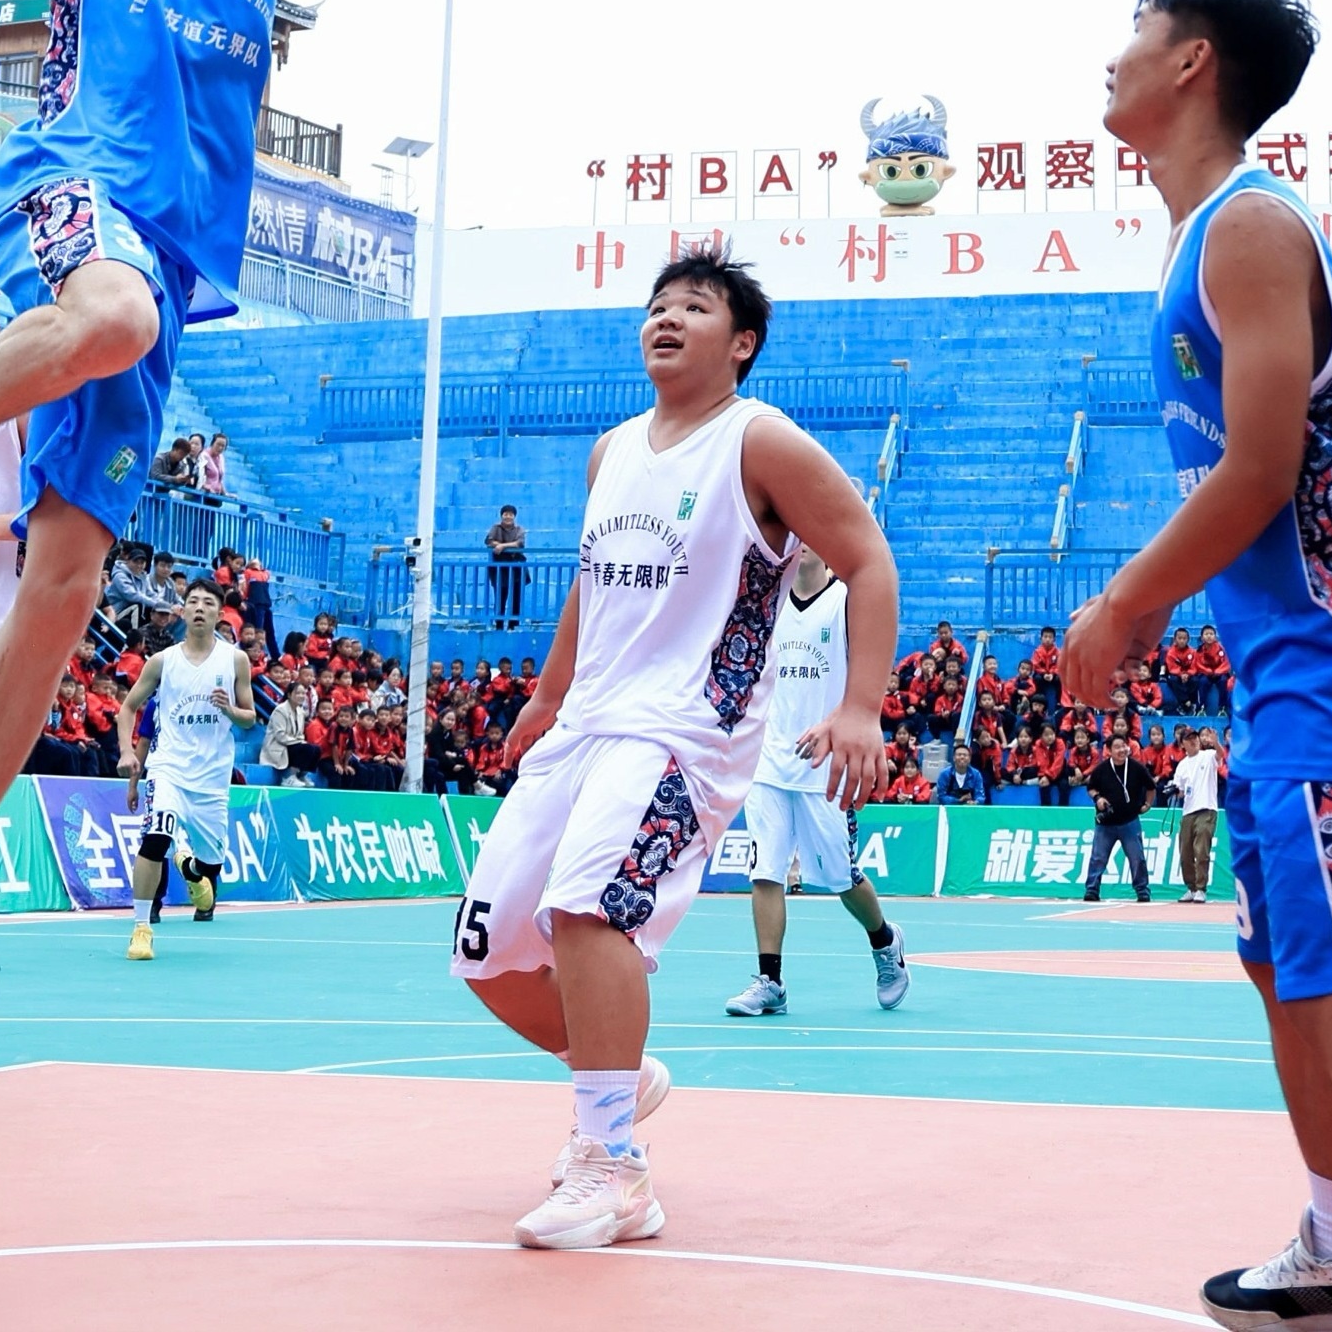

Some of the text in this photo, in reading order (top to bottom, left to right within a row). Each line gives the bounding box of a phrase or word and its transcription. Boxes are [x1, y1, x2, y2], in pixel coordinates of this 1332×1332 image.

[164, 6, 263, 68] 友谊无界队
[311, 205, 392, 285] 村BA
[579, 513, 689, 576] TEAM LIMITLESS YOUTH
[592, 561, 670, 590] 青春无限队
[775, 665, 821, 680] 春无限队
[154, 810, 175, 834] 10
[295, 811, 449, 885] 为农民呐喊
